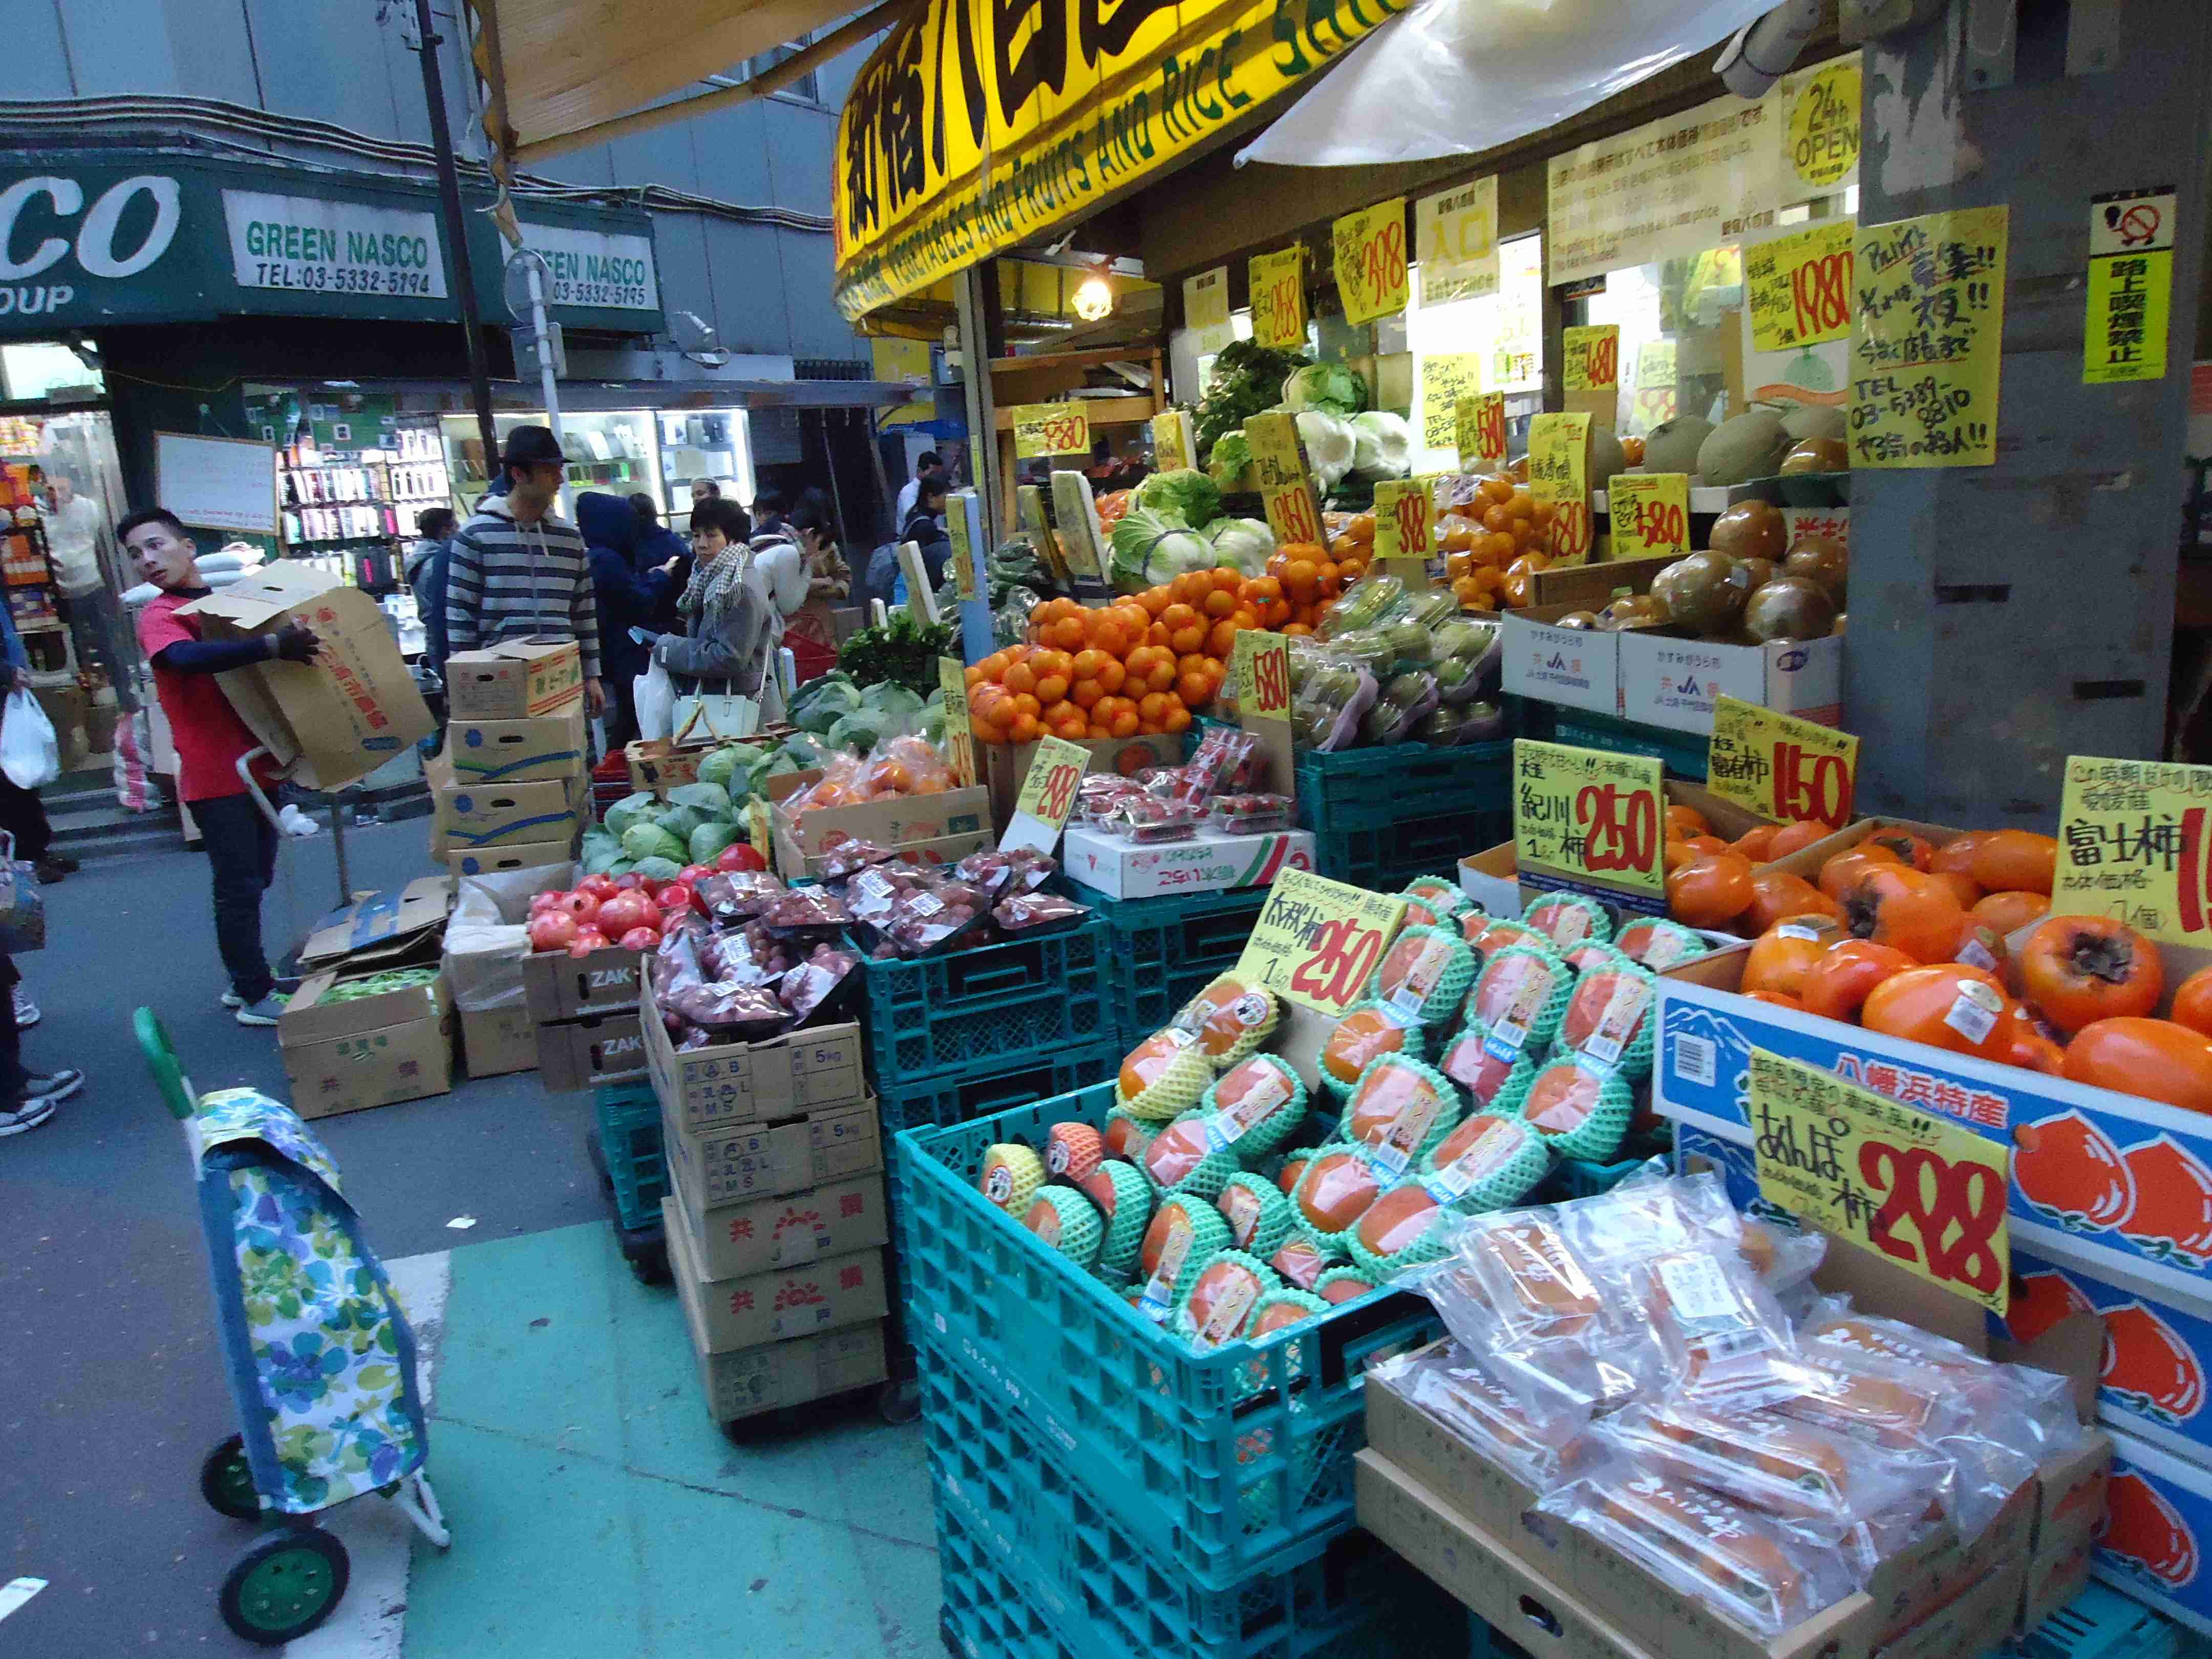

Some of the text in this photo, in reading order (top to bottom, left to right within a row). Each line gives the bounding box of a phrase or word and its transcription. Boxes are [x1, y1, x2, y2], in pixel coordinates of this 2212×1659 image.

[973, 180, 1013, 244] AND
[1012, 128, 1091, 224] FRUITS
[1096, 90, 1155, 183] AND
[1161, 28, 1251, 143] RICE
[1796, 124, 1858, 167] OPEN
[246, 221, 428, 269] GREEN NASCO
[586, 254, 645, 285] NASCO
[1793, 250, 1854, 338] 1980
[2106, 259, 2148, 364] 路上喫煙禁止
[1855, 376, 1903, 401] TEL
[1773, 742, 1851, 829] 150
[1576, 783, 1656, 873] 250
[2065, 814, 2188, 871] 富士柿
[1291, 918, 1382, 1007] 250
[1837, 1052, 2010, 1130] 八幡浜特産
